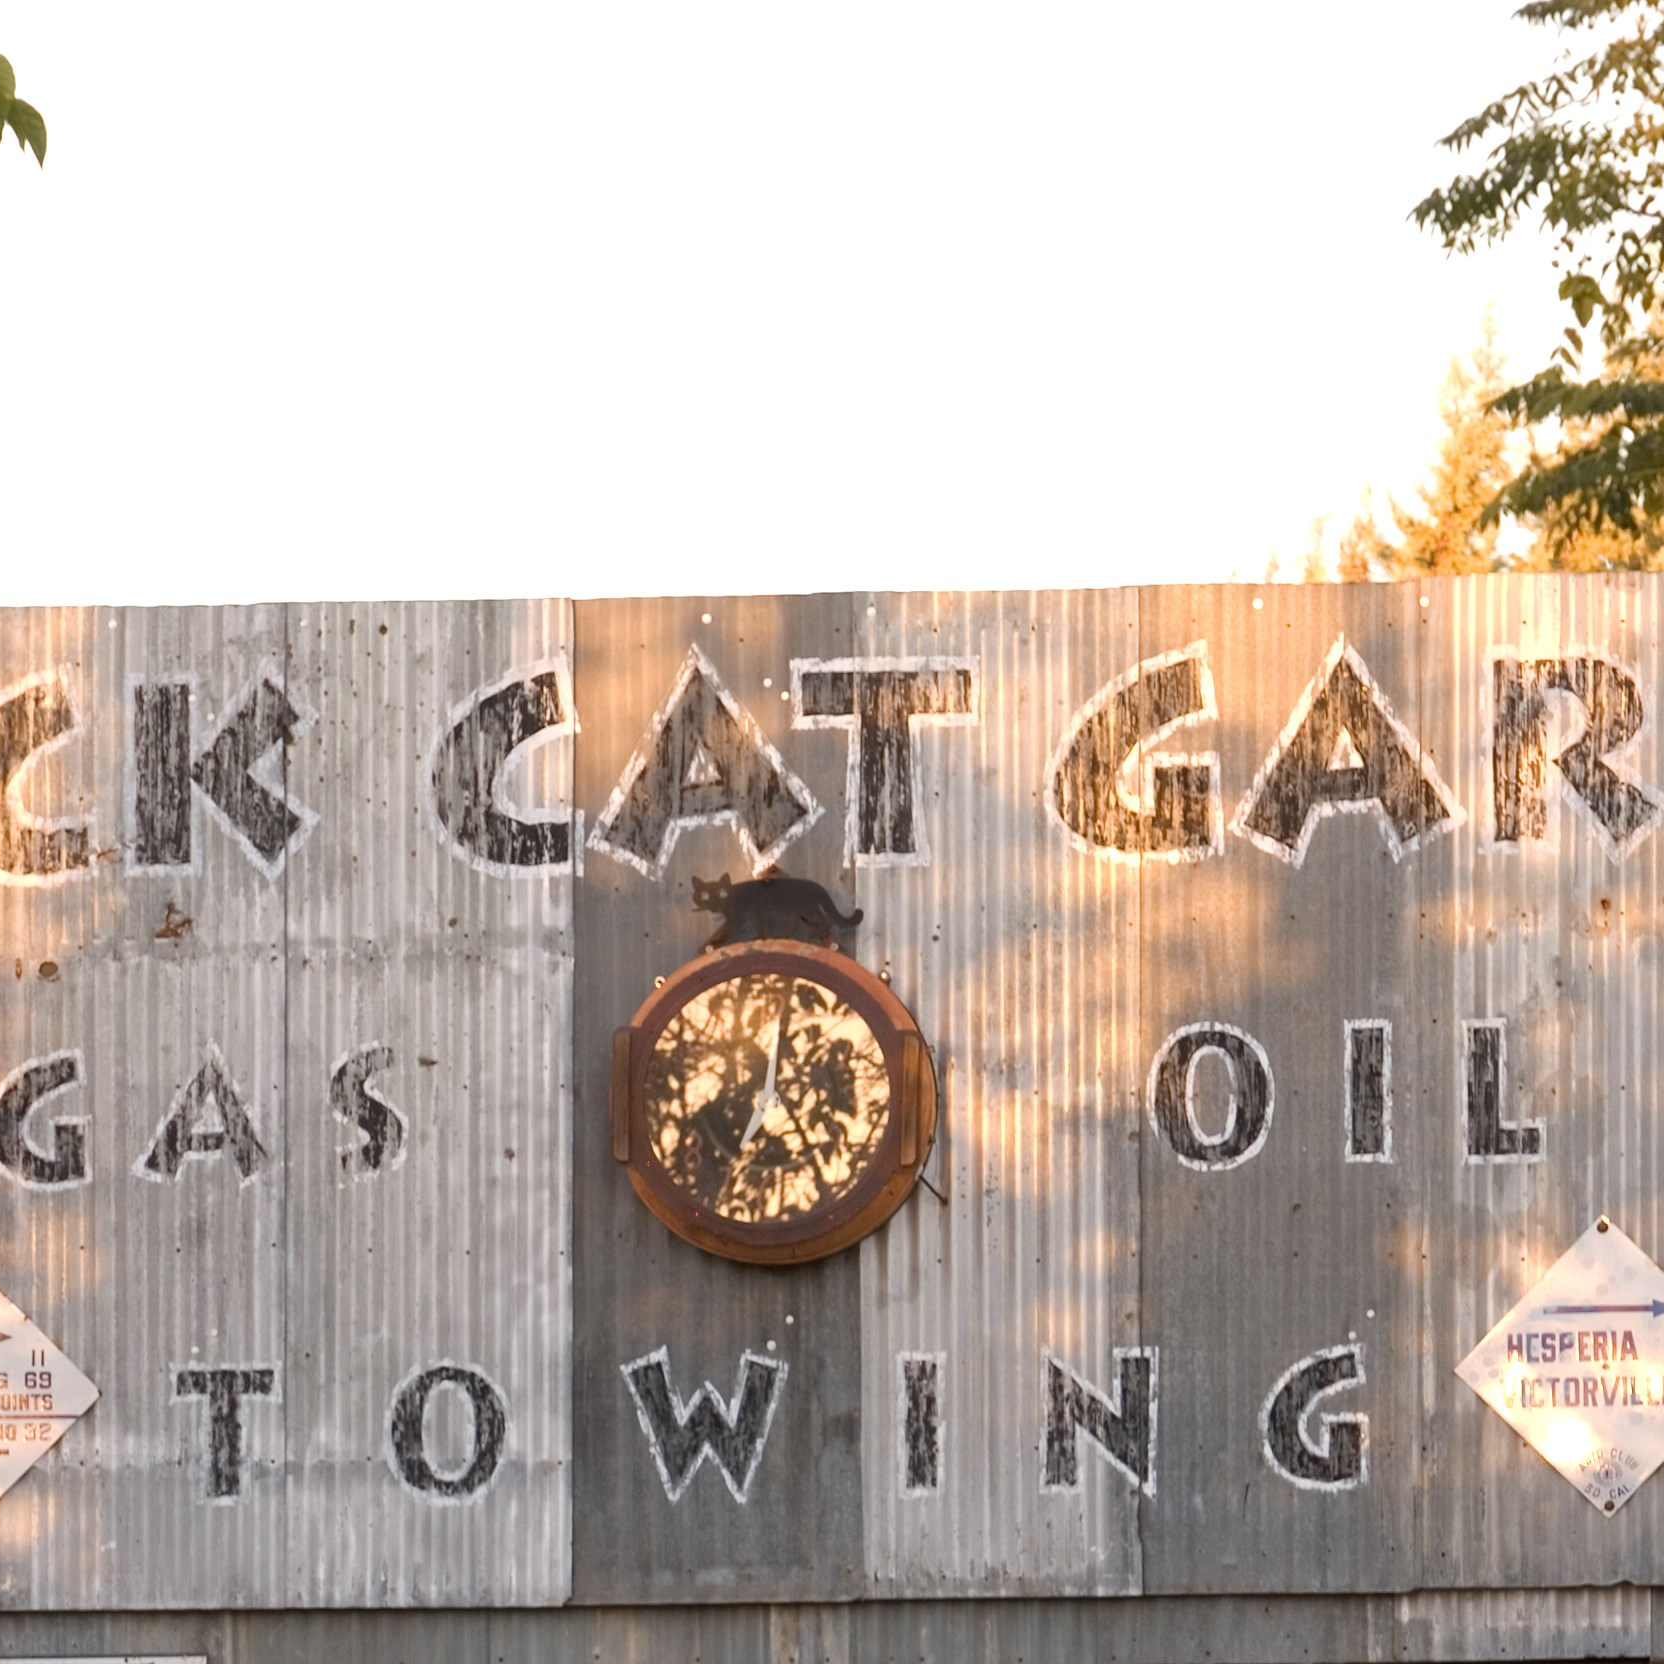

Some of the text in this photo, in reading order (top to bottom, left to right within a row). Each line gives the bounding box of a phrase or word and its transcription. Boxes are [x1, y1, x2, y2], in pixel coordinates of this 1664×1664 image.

[430, 640, 981, 877] CAT
[1146, 1016, 1547, 1171] OIL
[1507, 1330, 1639, 1363] HESPERIA
[24, 1371, 52, 1389] 69
[24, 1423, 52, 1441] 32
[170, 1342, 1371, 1505] TOWING
[1610, 1448, 1640, 1471] CLUB
